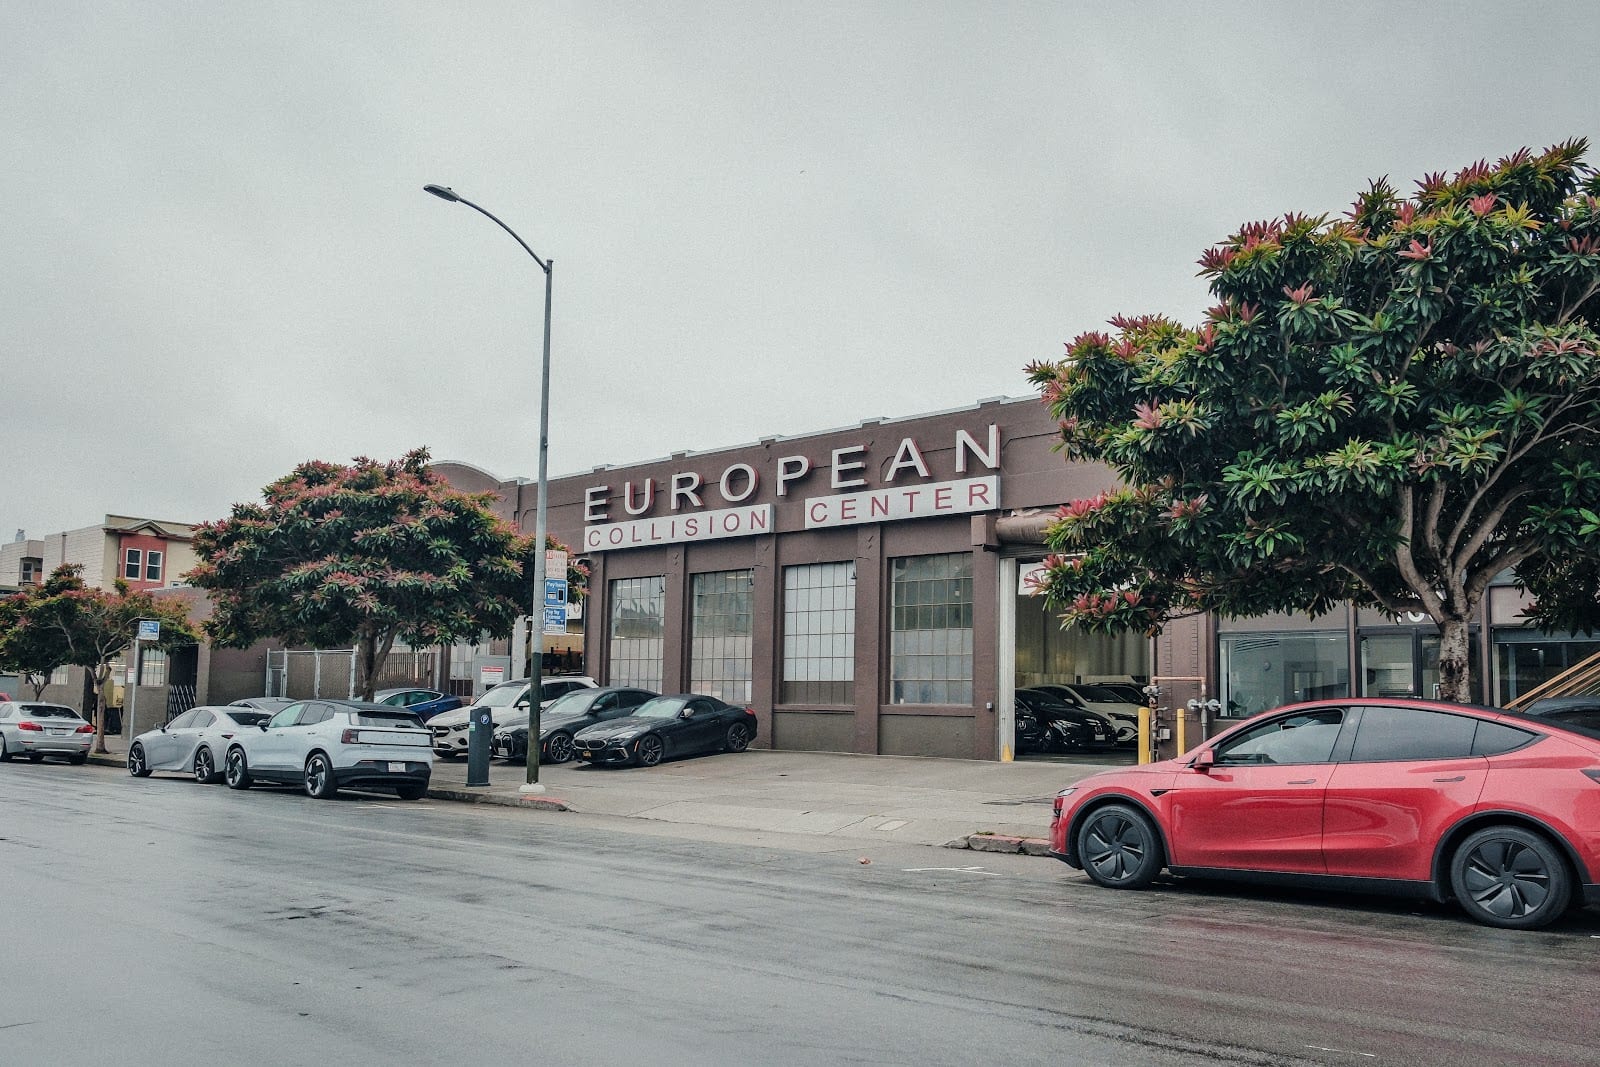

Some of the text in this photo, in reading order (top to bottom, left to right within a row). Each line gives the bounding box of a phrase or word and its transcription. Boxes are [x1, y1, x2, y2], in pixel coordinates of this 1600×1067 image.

[584, 423, 1000, 522] EUROPEAN
[588, 483, 990, 547] COLLISION CENTER
